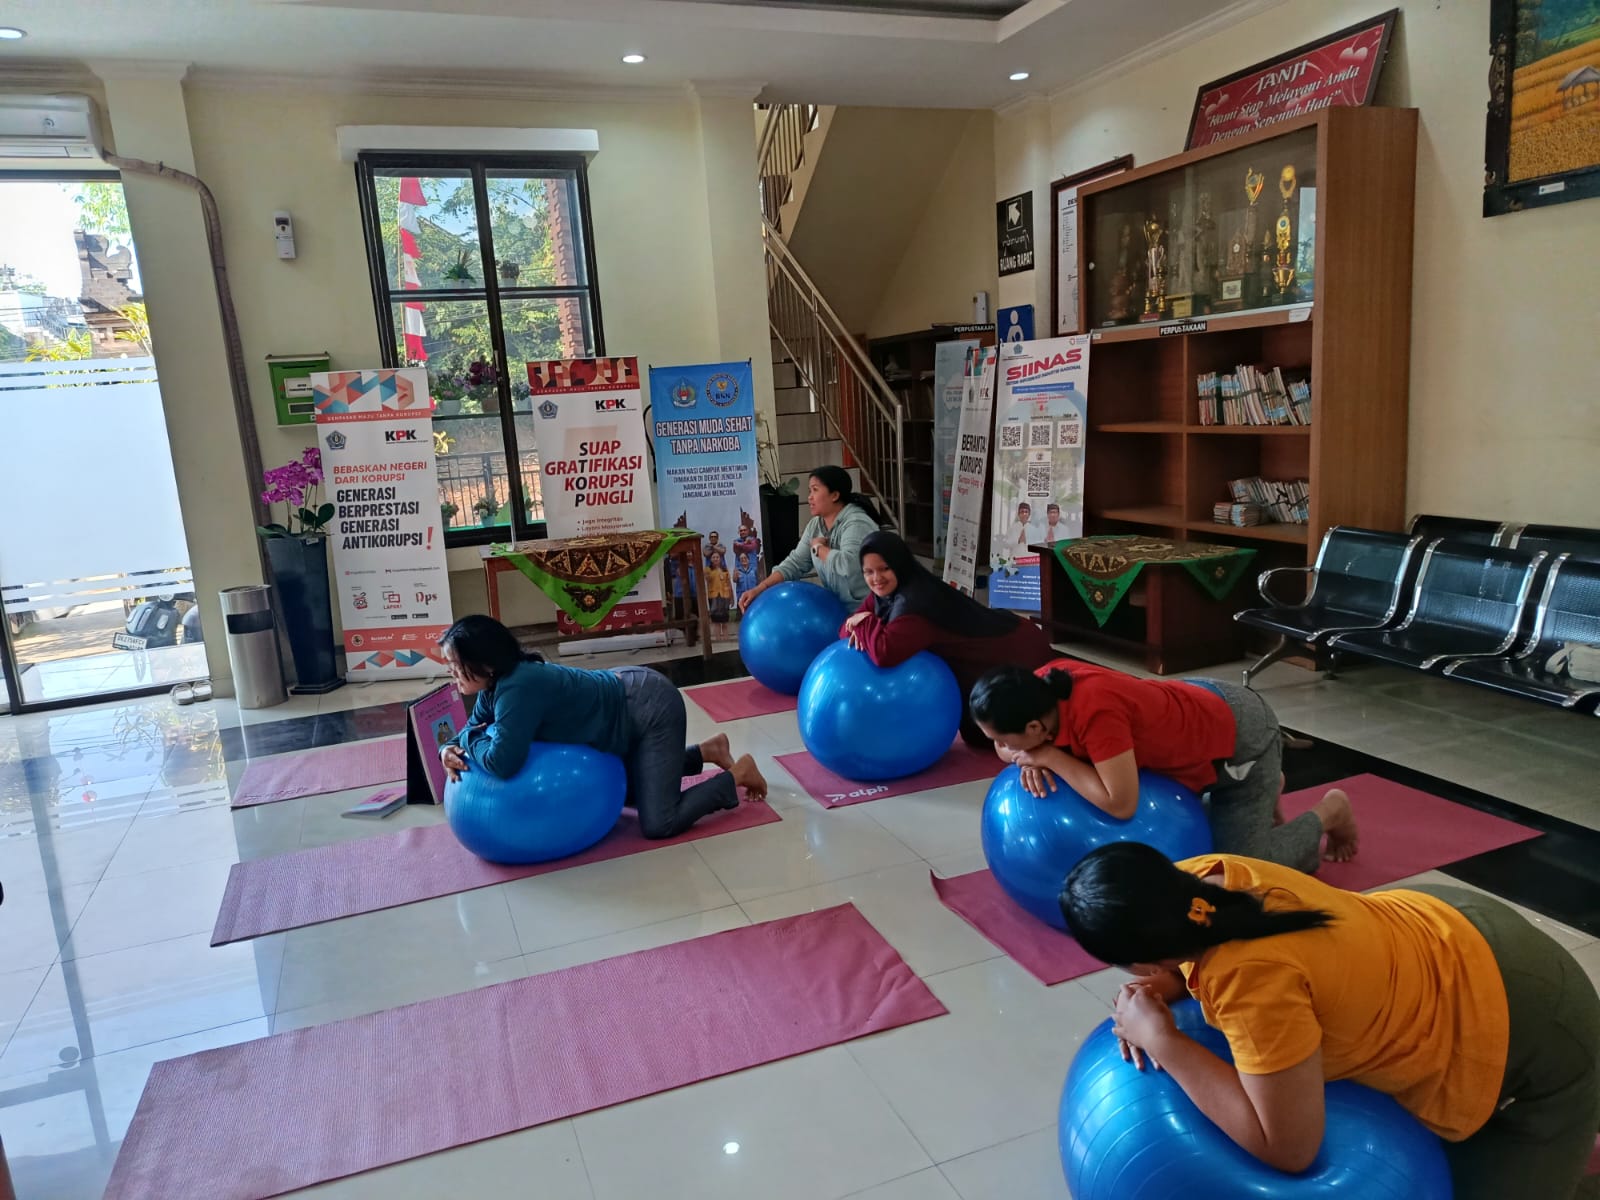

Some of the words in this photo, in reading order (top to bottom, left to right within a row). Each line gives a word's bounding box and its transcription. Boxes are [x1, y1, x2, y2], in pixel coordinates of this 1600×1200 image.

[1256, 60, 1309, 95] JANJI
[1240, 100, 1263, 118] Siap
[1265, 76, 1323, 107] Melayani
[1324, 65, 1359, 87] Anda
[1000, 256, 1017, 271] RUANG
[1017, 250, 1032, 268] RAPAT
[1161, 322, 1206, 335] PERPUSTAKAAN
[1007, 348, 1082, 380] SIINAS
[595, 399, 626, 410] KPK
[656, 420, 697, 437] GENERASI
[699, 418, 724, 434] MUDA
[725, 416, 752, 432] SEHAT
[385, 430, 416, 441] KPK
[579, 440, 621, 456] SUAP
[671, 438, 699, 455] TANPA
[700, 436, 741, 453] NARKOBA
[334, 464, 387, 474] BEBASKAN
[390, 462, 427, 471] NEGERI
[545, 456, 642, 475] GRATIFIKASI
[335, 476, 358, 484] DARI
[362, 473, 405, 483] KORUPSI
[565, 473, 633, 491] KORUPSI
[337, 487, 395, 502] GENERASI
[575, 490, 633, 507] PUNGLI
[339, 501, 419, 518] BERPRESTASI
[340, 518, 399, 534] GENERASI
[849, 785, 888, 798] alph
